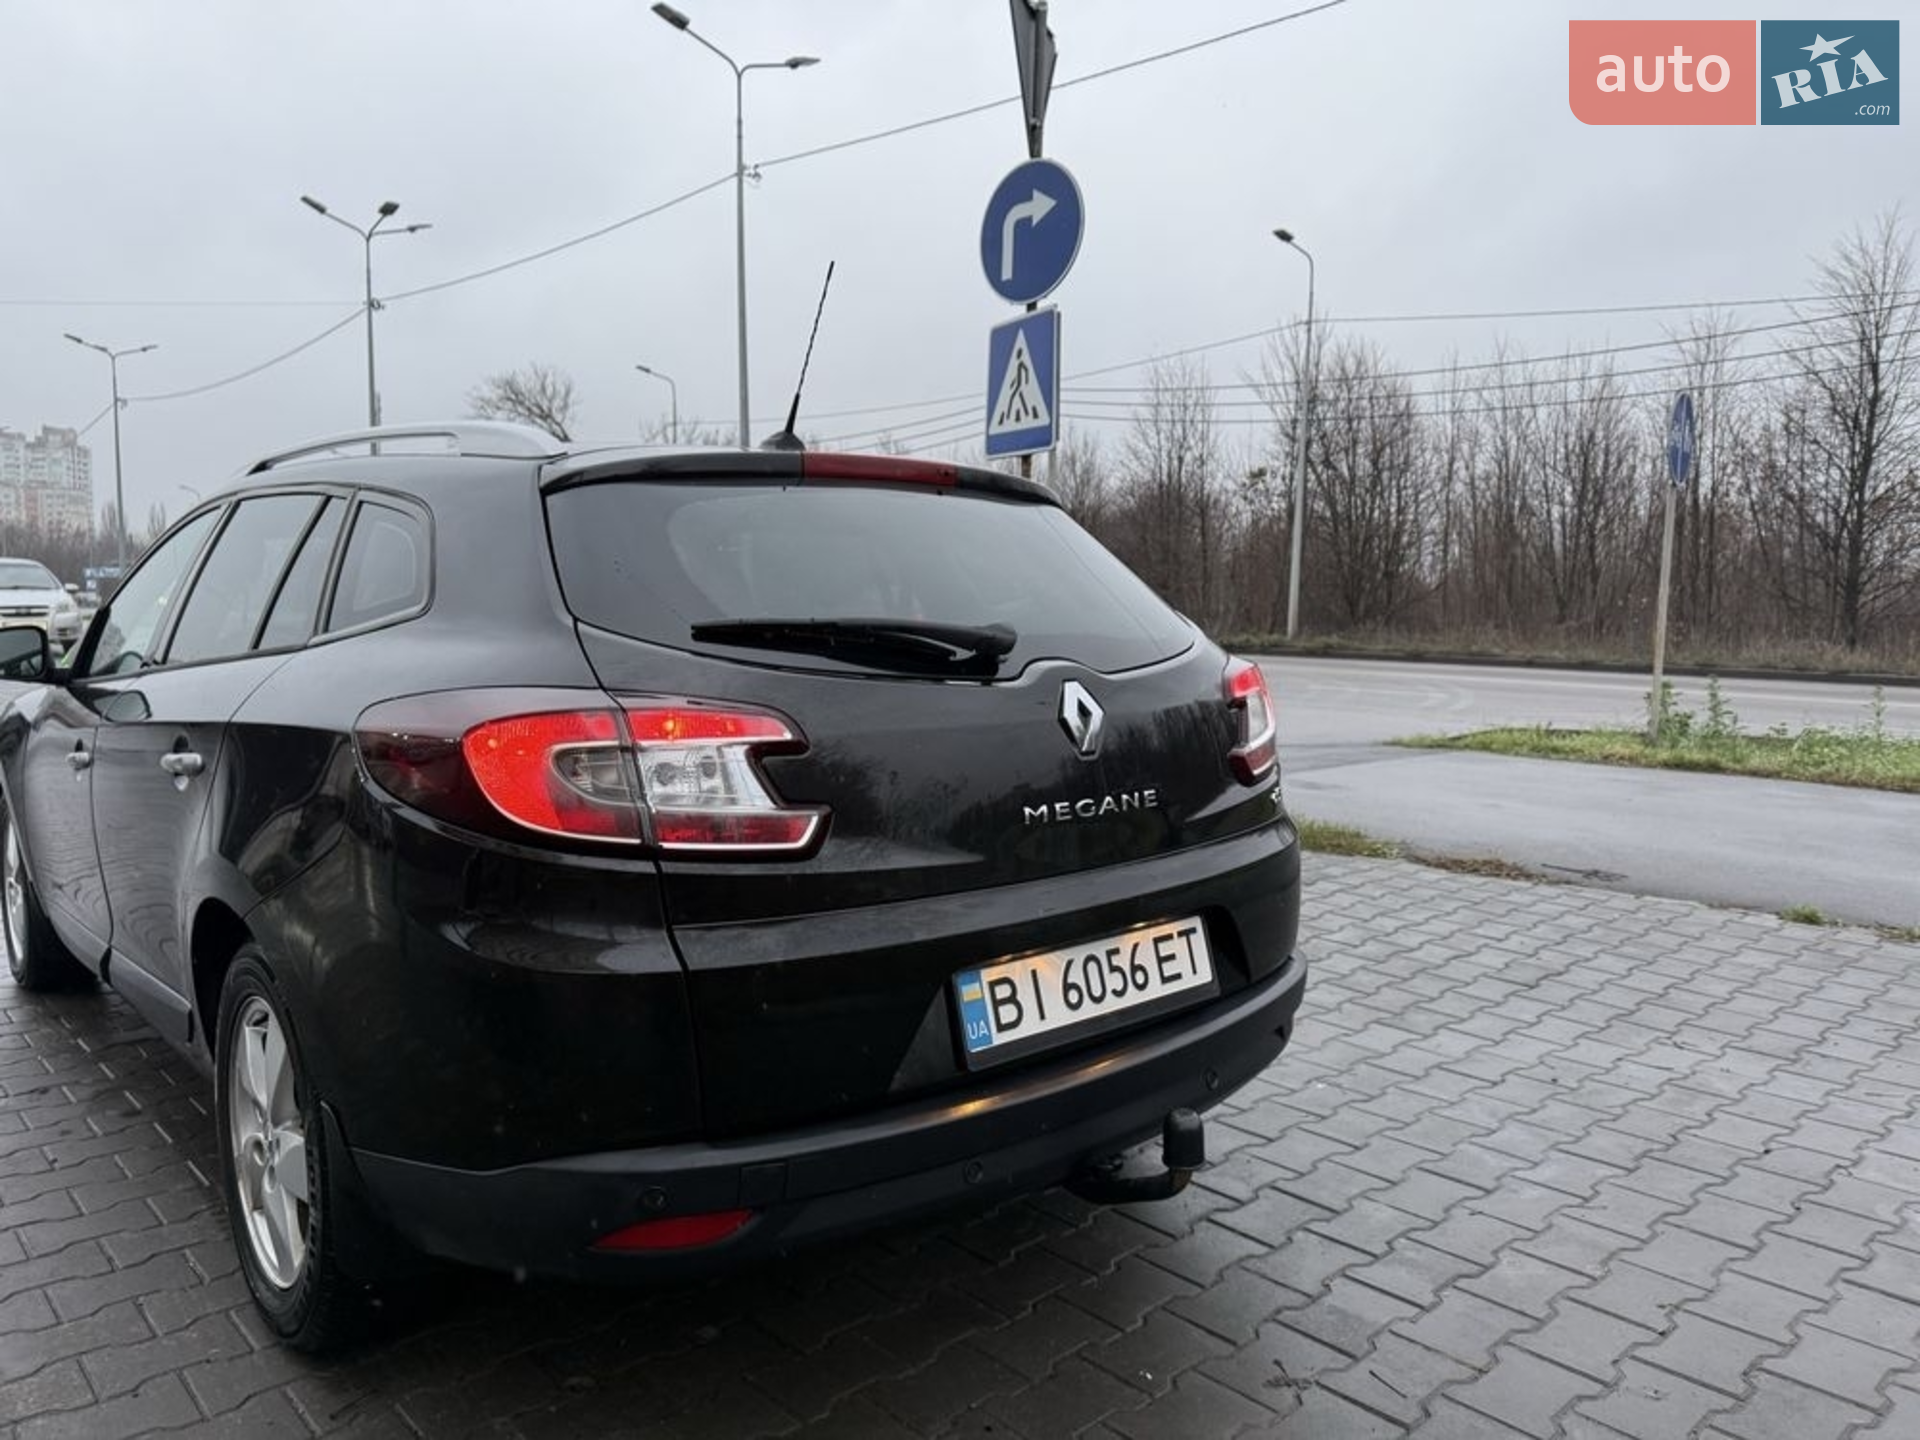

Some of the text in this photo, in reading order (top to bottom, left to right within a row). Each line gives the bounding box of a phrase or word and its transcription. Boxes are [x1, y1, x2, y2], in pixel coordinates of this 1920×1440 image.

[1023, 789, 1158, 825] MEGANE
[988, 927, 1198, 1034] BI 6056 ET
[967, 1020, 990, 1041] UA
